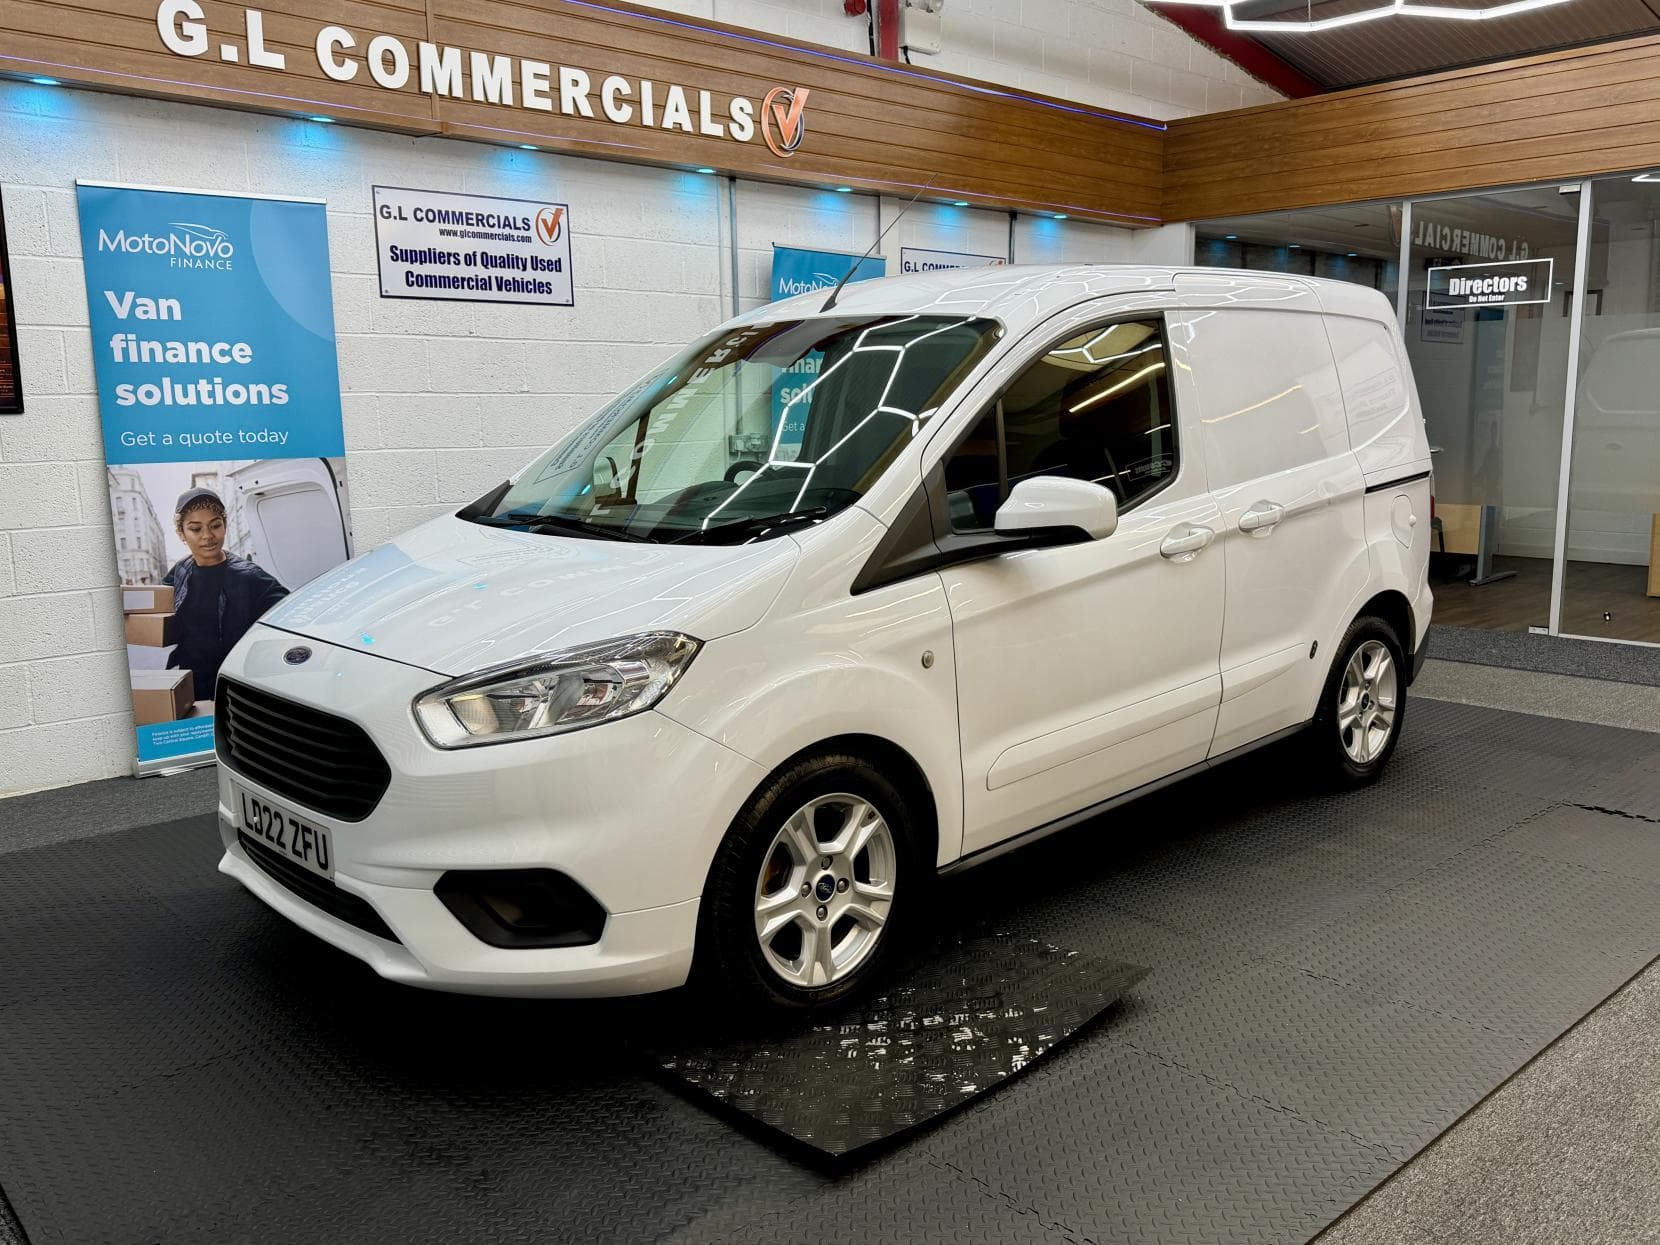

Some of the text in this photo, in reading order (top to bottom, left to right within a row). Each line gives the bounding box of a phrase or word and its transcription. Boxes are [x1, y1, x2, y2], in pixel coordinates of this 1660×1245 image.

[156, 0, 755, 142] G.L COMMERCIALS
[379, 204, 531, 231] G.L COMMERCIALS
[98, 228, 234, 258] MotoNovo
[439, 227, 532, 243] www.glcommercials.com
[170, 257, 232, 271] FINANCE
[389, 244, 562, 273] Suppliers of Quality Used
[405, 270, 553, 295] Commercial Vehicles
[779, 277, 838, 295] MotoN
[1448, 276, 1528, 295] Directors
[104, 290, 182, 321] Van
[110, 333, 253, 364] finance
[115, 377, 290, 406] solutions
[120, 428, 289, 447] Get a quote today
[242, 792, 329, 871] LD22 ZFU
